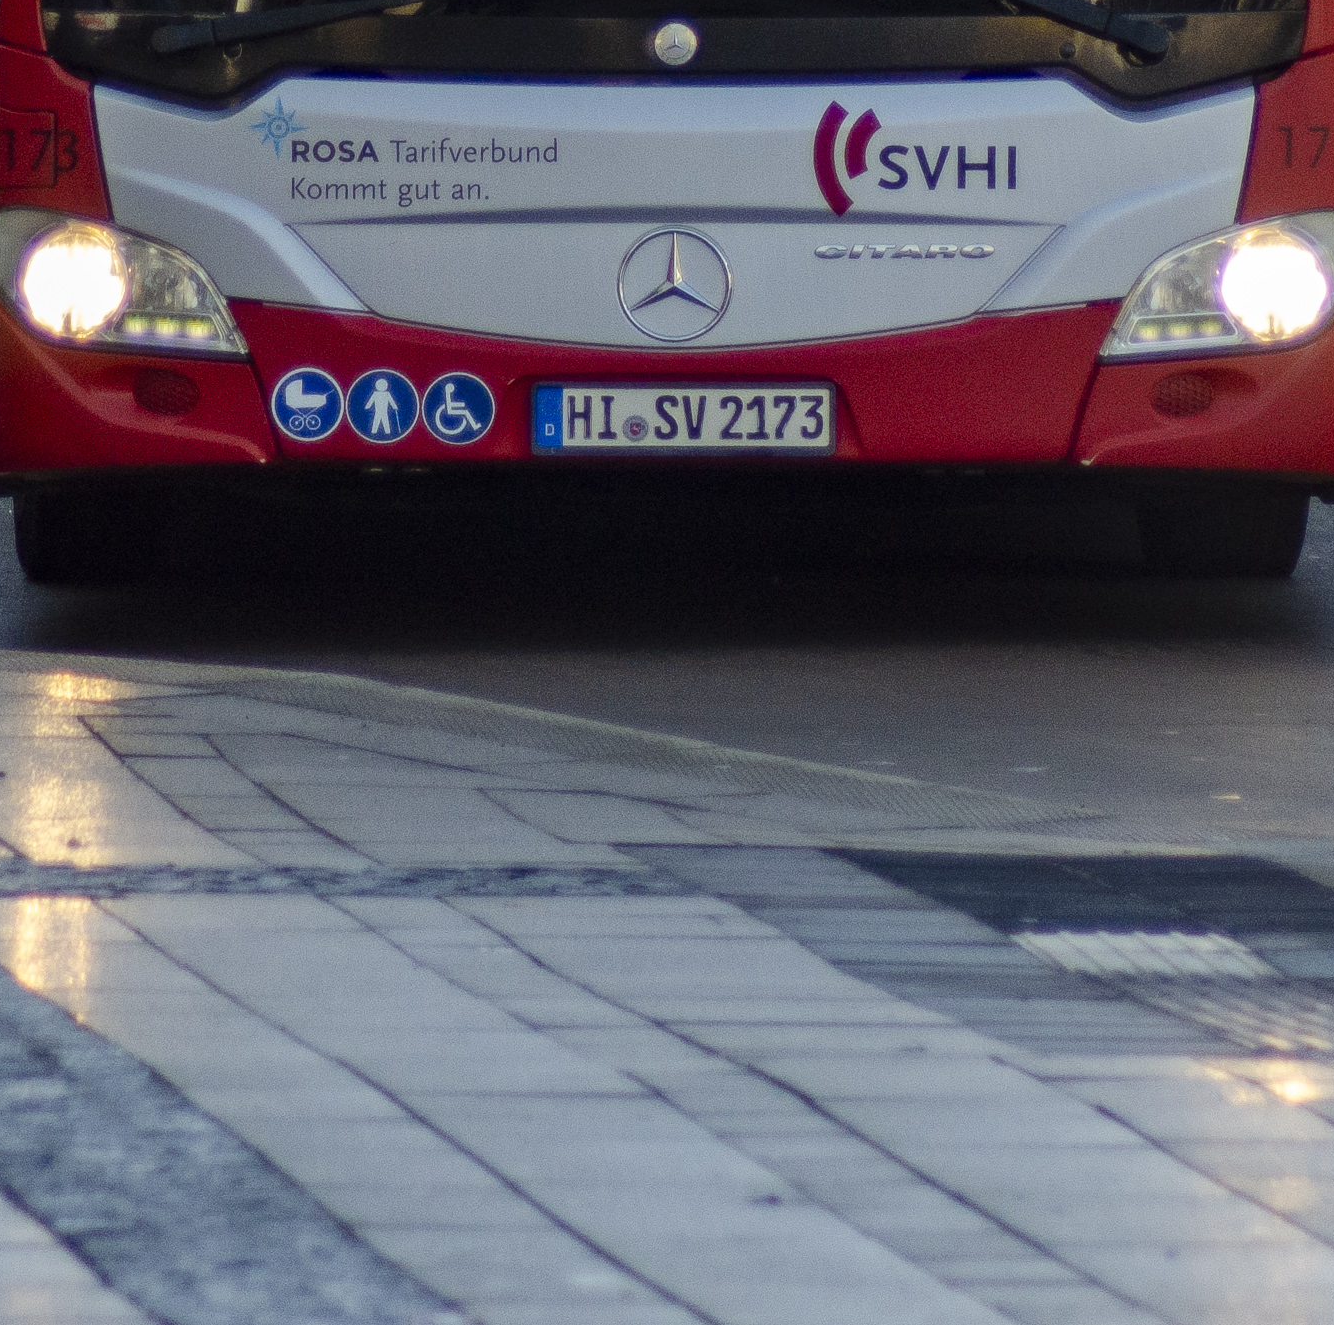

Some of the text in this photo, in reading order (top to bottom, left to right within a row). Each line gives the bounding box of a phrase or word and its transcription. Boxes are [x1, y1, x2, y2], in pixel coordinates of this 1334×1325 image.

[2, 128, 79, 174] 173
[290, 137, 559, 164] ROSA Tarifverbund
[877, 144, 1018, 191] SVHI
[290, 176, 490, 208] Kommt gut an.
[813, 243, 996, 260] CITARO
[544, 395, 825, 441] D HI SV 2173
